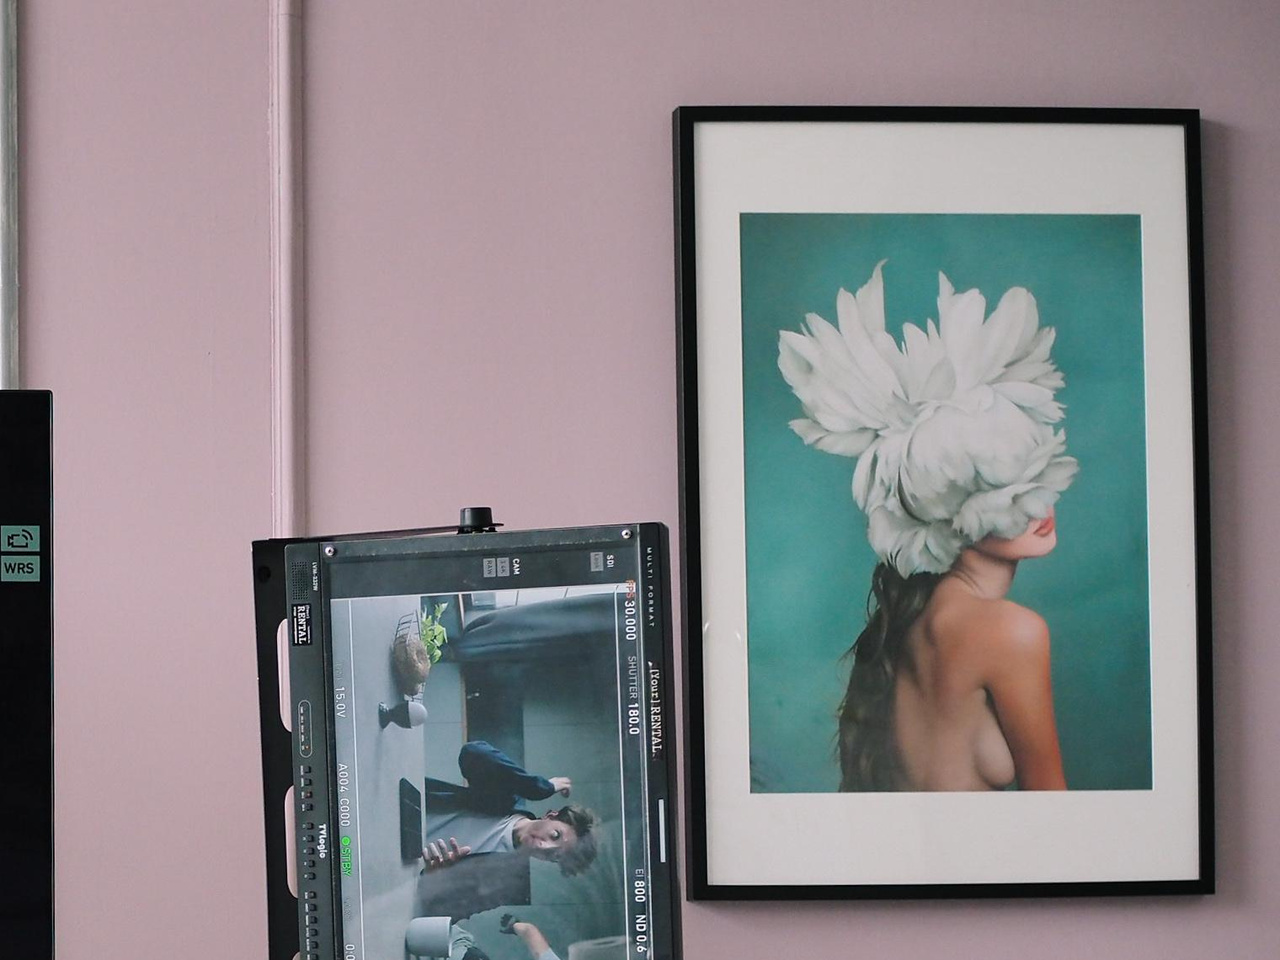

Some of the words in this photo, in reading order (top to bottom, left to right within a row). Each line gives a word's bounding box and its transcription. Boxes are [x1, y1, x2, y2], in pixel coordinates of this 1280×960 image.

[4, 561, 35, 575] WRS
[297, 606, 306, 644] RENTAL
[625, 601, 636, 640] 30.000
[628, 656, 638, 699] SHUTTER
[336, 687, 346, 717] 15.0V
[629, 702, 639, 735] 180.0
[652, 707, 662, 752] RENTAL
[338, 763, 348, 792] A004
[340, 798, 350, 826] C000
[342, 848, 351, 876] STBY
[635, 880, 645, 902] 800
[636, 915, 646, 931] ND
[637, 935, 647, 952] 0.6
